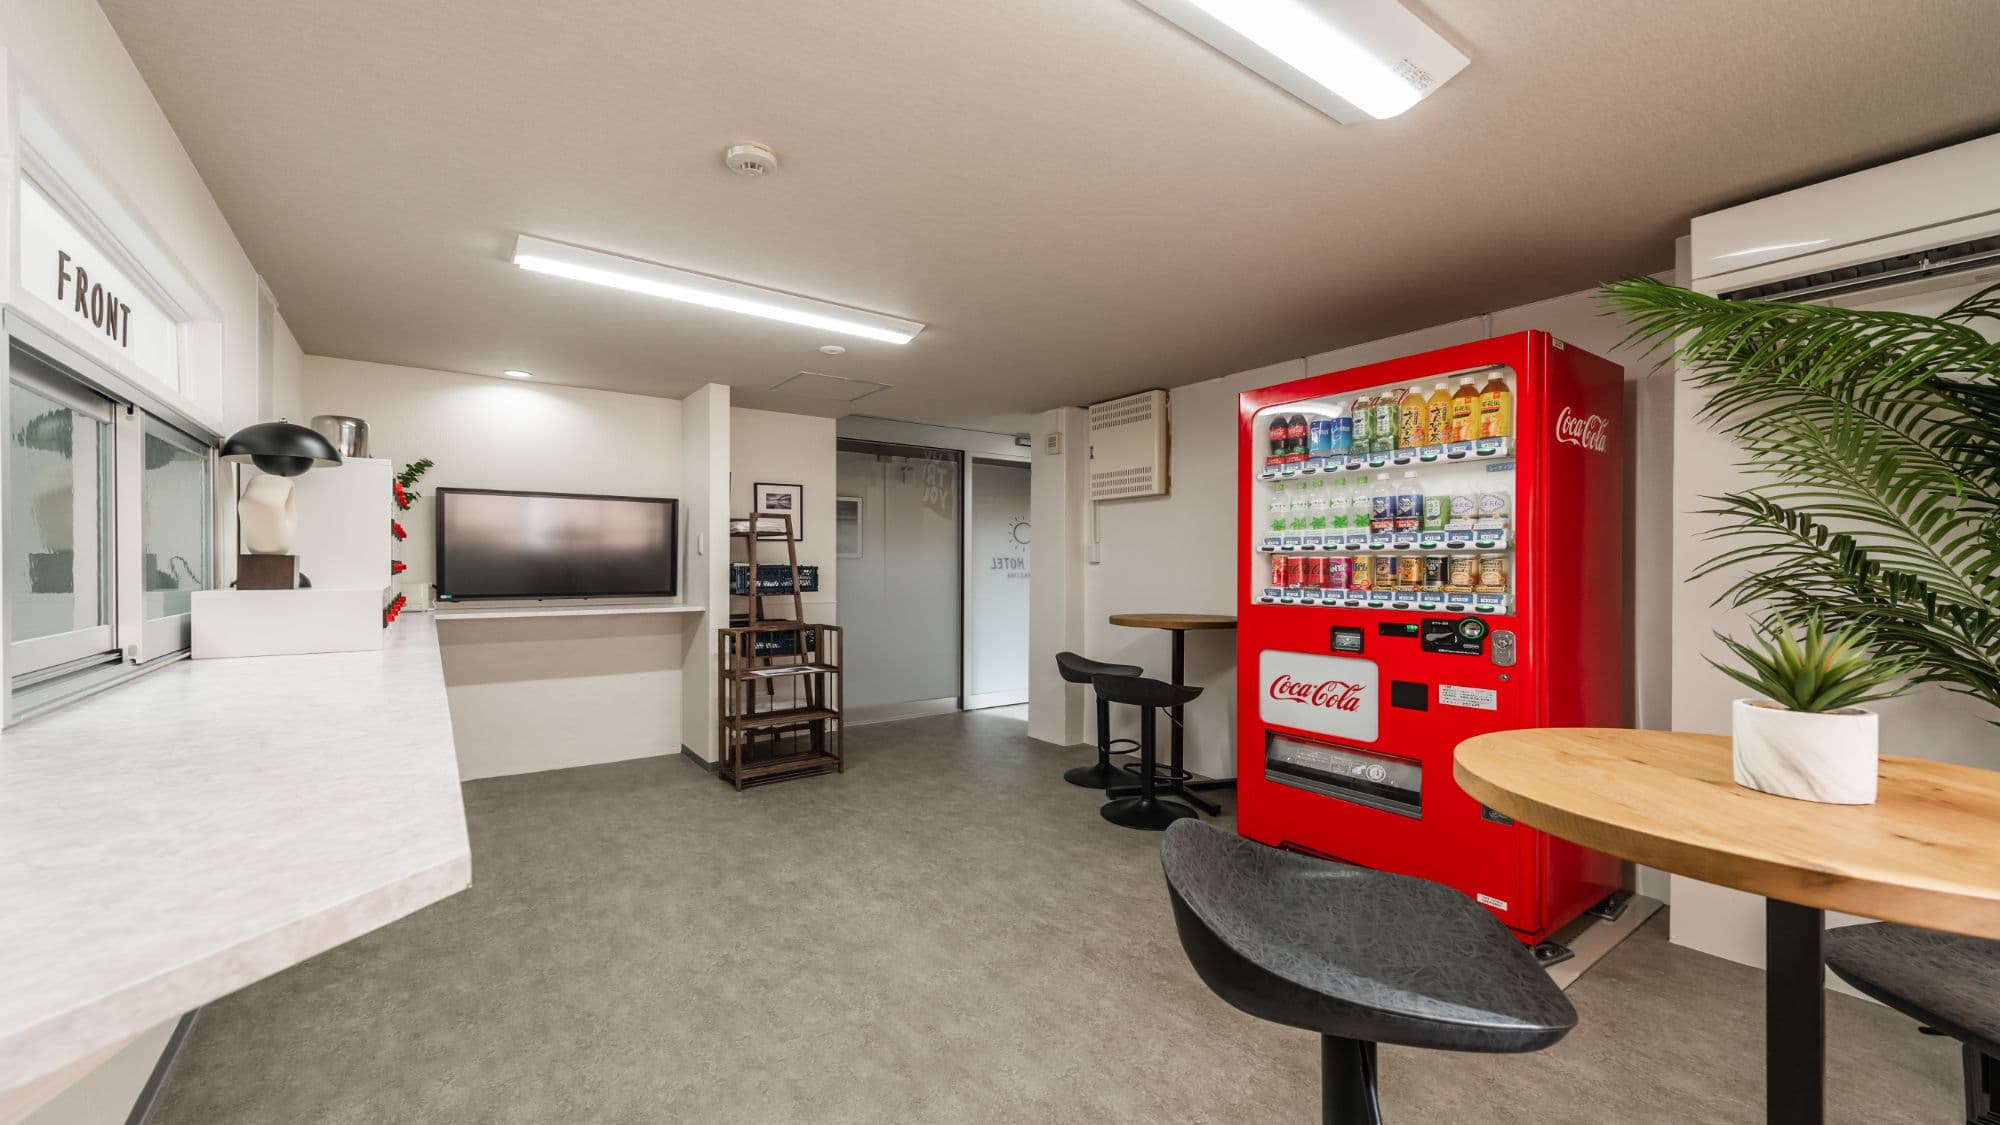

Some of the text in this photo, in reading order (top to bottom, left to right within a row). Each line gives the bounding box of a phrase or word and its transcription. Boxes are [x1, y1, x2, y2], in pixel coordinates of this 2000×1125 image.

[57, 249, 131, 348] FRONT
[1556, 406, 1609, 452] Coca-Cola
[1269, 674, 1367, 712] Coca-Cola
